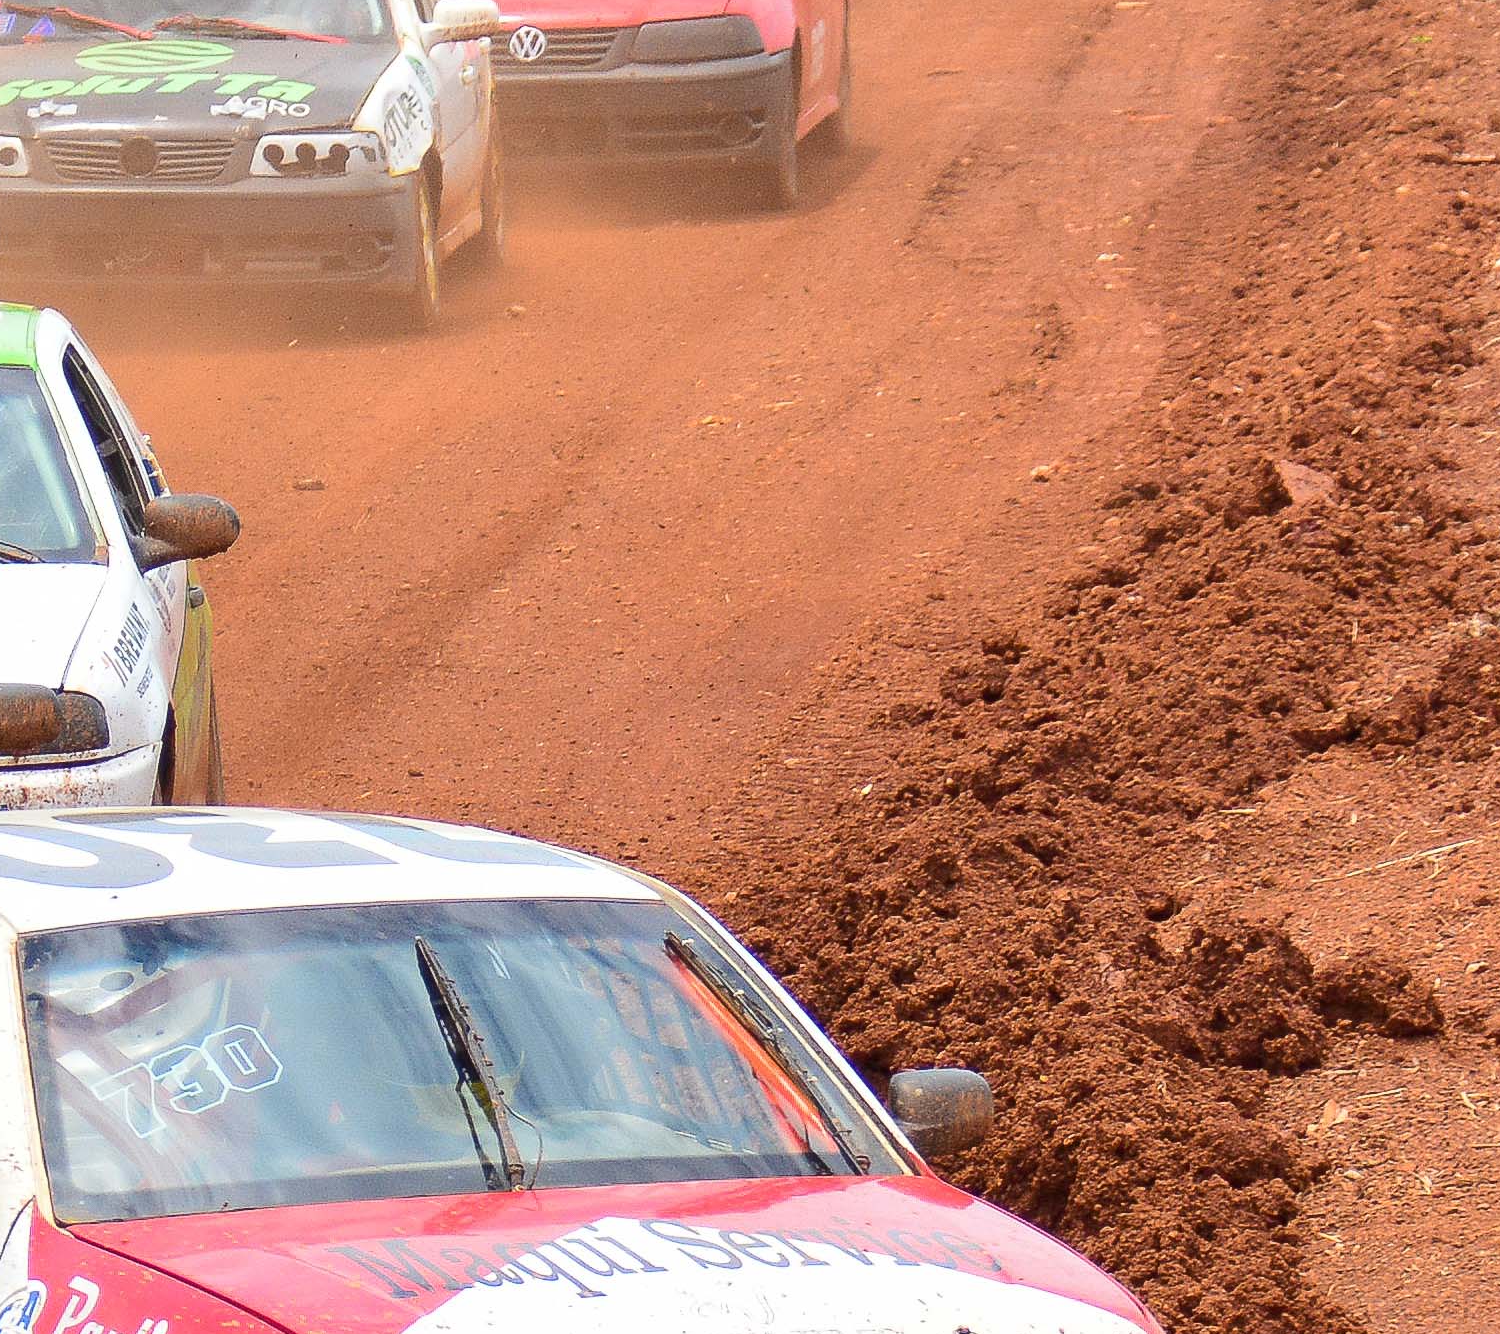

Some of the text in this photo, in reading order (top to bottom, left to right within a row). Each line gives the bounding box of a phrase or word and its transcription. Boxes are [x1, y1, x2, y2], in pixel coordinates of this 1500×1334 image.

[92, 1022, 285, 1139] 730
[331, 1215, 1003, 1299] Maqui Service
